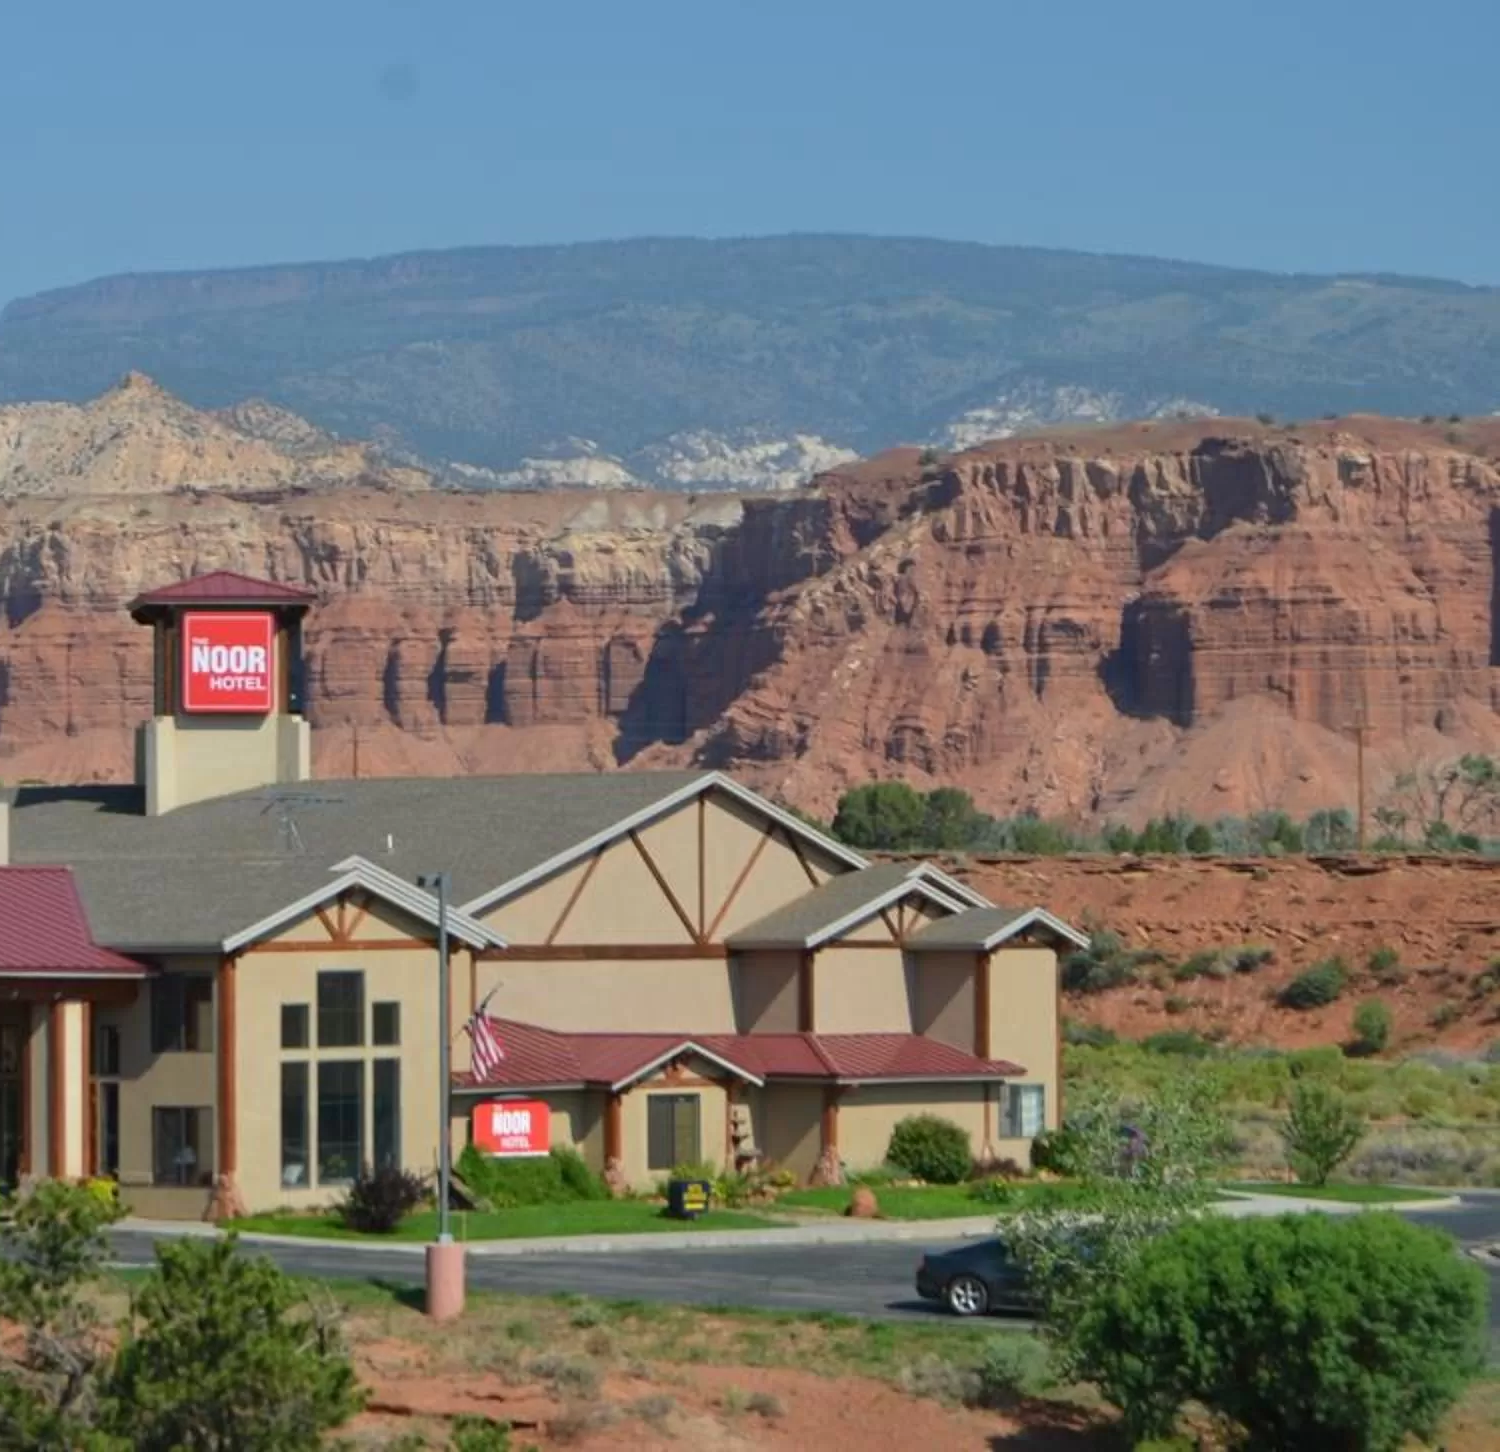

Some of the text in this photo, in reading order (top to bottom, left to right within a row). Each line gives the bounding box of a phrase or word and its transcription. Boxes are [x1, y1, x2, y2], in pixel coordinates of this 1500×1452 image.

[191, 645, 266, 674] NOOR
[209, 676, 267, 691] HOTEL
[492, 1110, 531, 1135] NOOR
